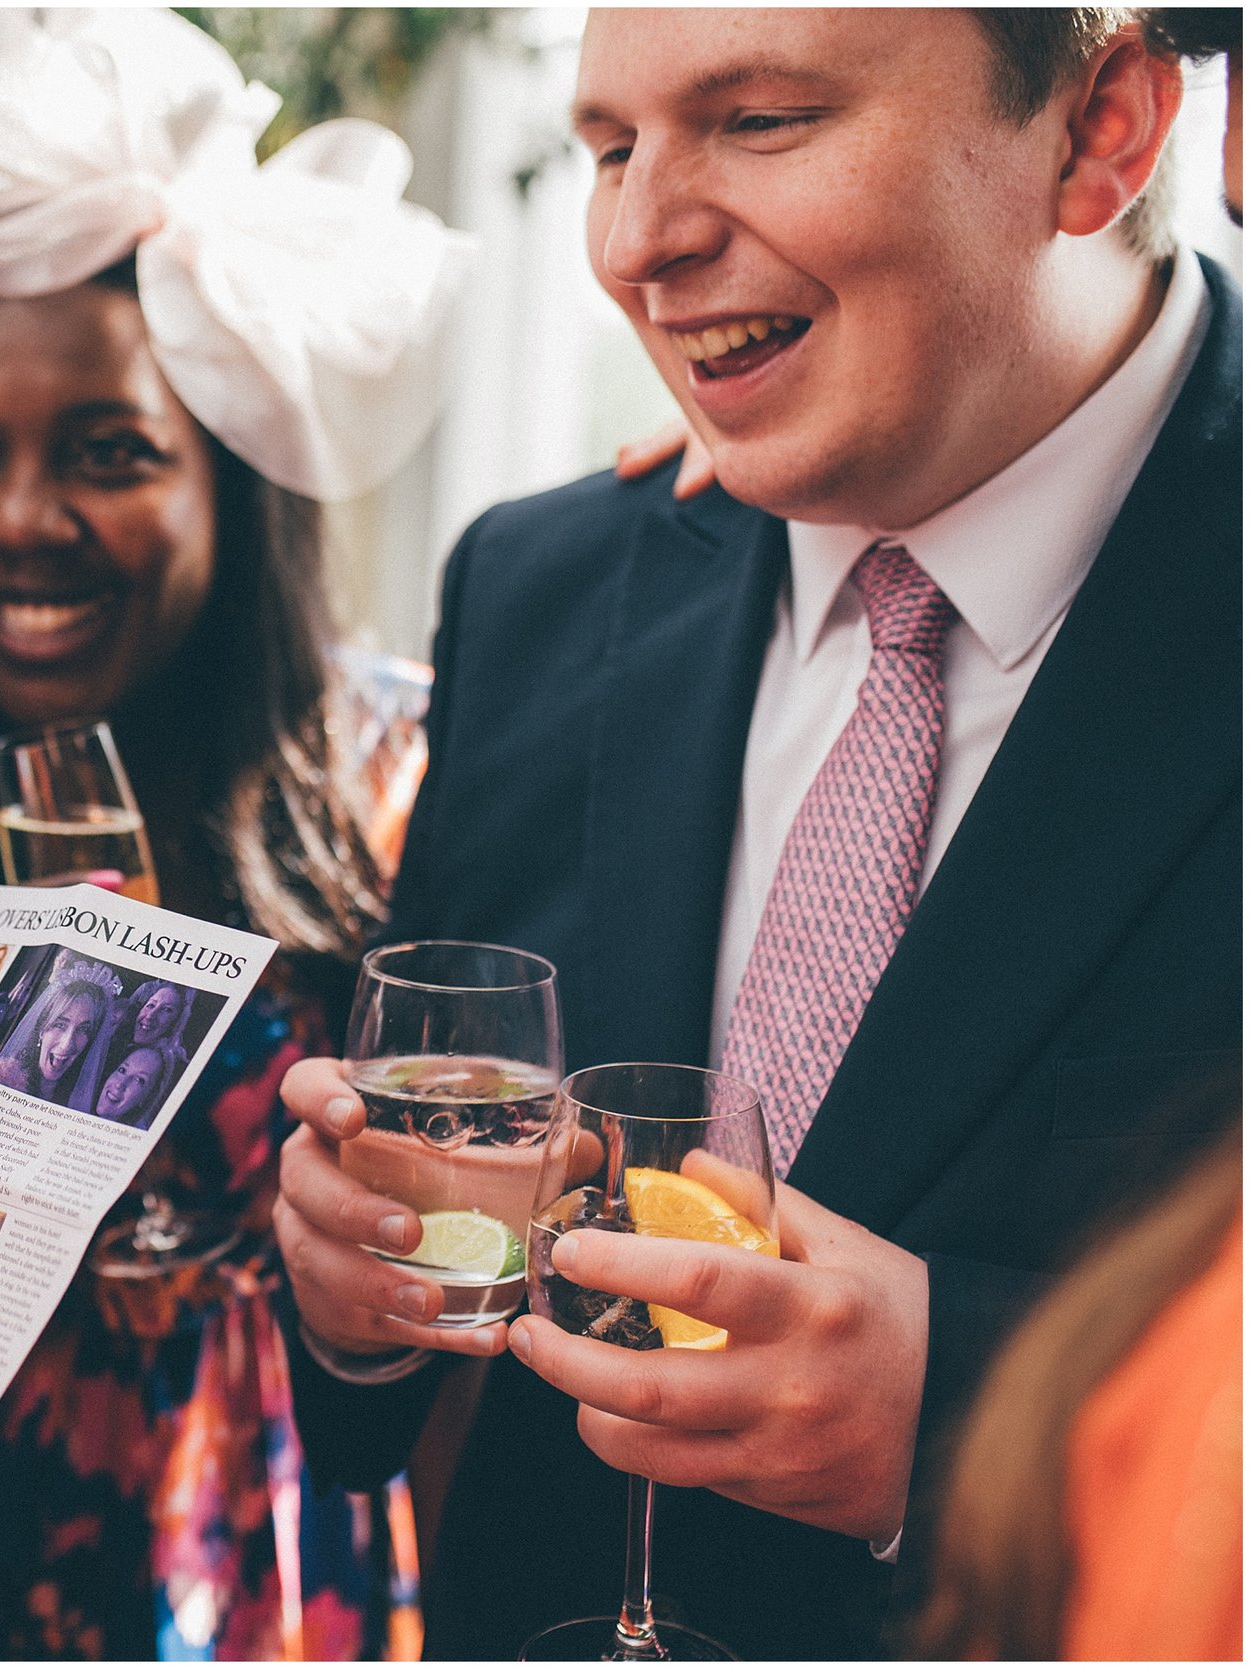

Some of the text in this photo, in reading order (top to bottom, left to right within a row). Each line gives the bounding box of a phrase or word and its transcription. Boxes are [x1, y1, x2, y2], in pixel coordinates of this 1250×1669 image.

[46, 906, 119, 943] LISBON
[118, 924, 247, 980] LASH-UPS
[12, 1096, 29, 1105] party
[49, 1106, 64, 1115] loose
[73, 1114, 92, 1124] Lisbon
[6, 1108, 21, 1118] clubs,
[41, 1120, 59, 1129] which
[88, 1135, 106, 1144] chance
[12, 1146, 29, 1154] which
[28, 1149, 40, 1157] had
[2, 1153, 29, 1165] decorated
[22, 1194, 36, 1202] right
